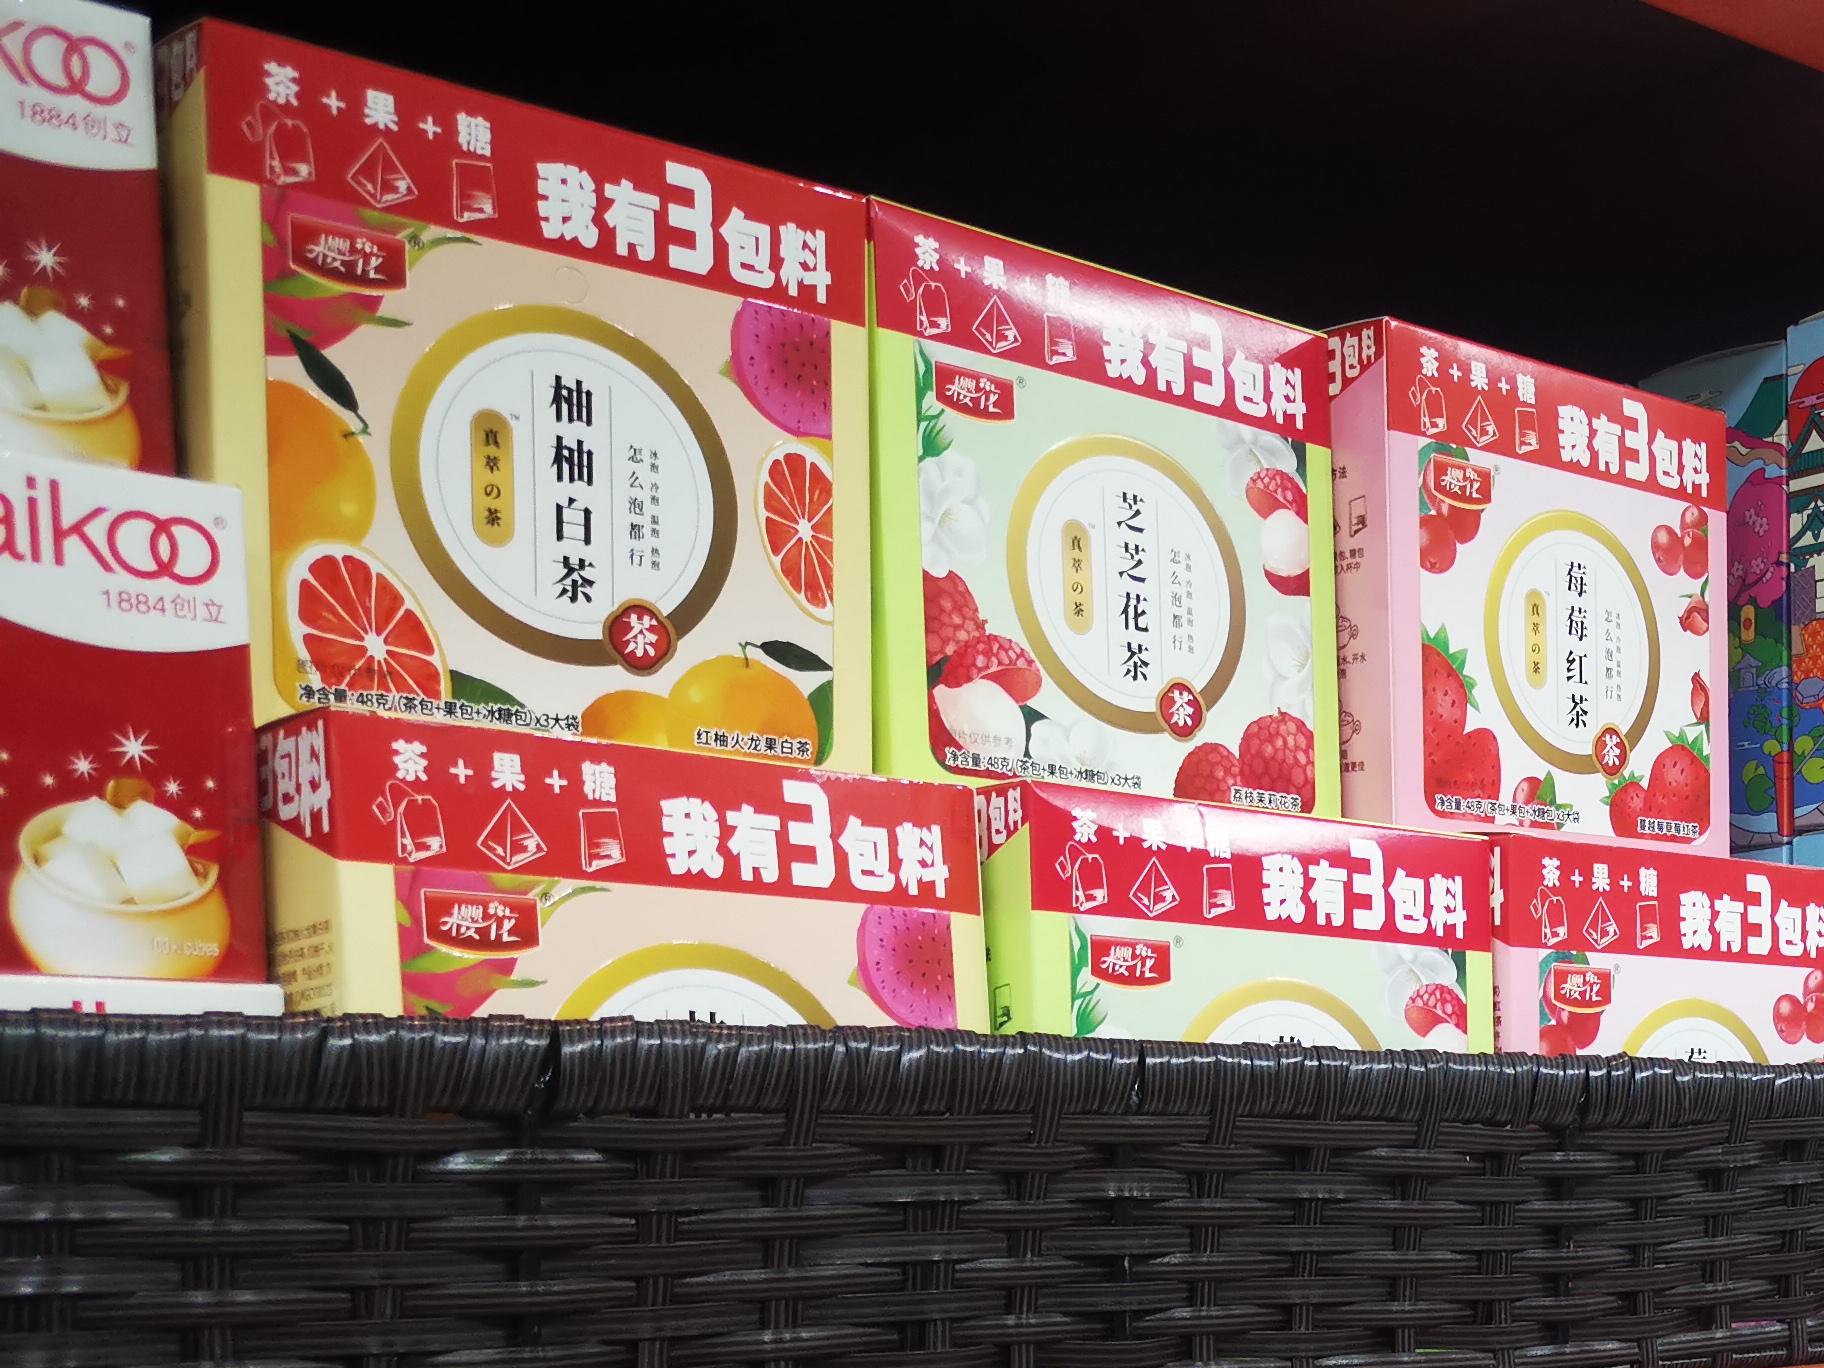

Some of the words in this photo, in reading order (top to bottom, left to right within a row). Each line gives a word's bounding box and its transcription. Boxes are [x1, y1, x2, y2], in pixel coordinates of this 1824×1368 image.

[17, 98, 136, 146] 1884创立
[536, 160, 833, 306] 我有3包料
[1101, 312, 1307, 430] 我有3包料
[483, 428, 502, 528] 真萃の茶
[549, 374, 596, 604] 柚柚白茶
[1557, 398, 1710, 498] 我有3包料
[627, 444, 645, 568] 怎么泡都行
[101, 588, 227, 626] 1884创立
[621, 609, 661, 659] 茶
[1114, 490, 1151, 684] 芝芝花茶
[1169, 547, 1185, 652] 怎么泡都行
[1564, 560, 1589, 730] 莓莓红茶
[695, 727, 811, 758] 红柚火龙果白茶
[1167, 688, 1194, 729] 茶
[1600, 733, 1621, 768] 茶
[659, 779, 951, 899] 我有3包料
[1232, 788, 1302, 812] 荔枝茉莉花茶
[1638, 818, 1700, 839] 蔓越莓草莓红茶
[1261, 838, 1468, 940] 我有3包料
